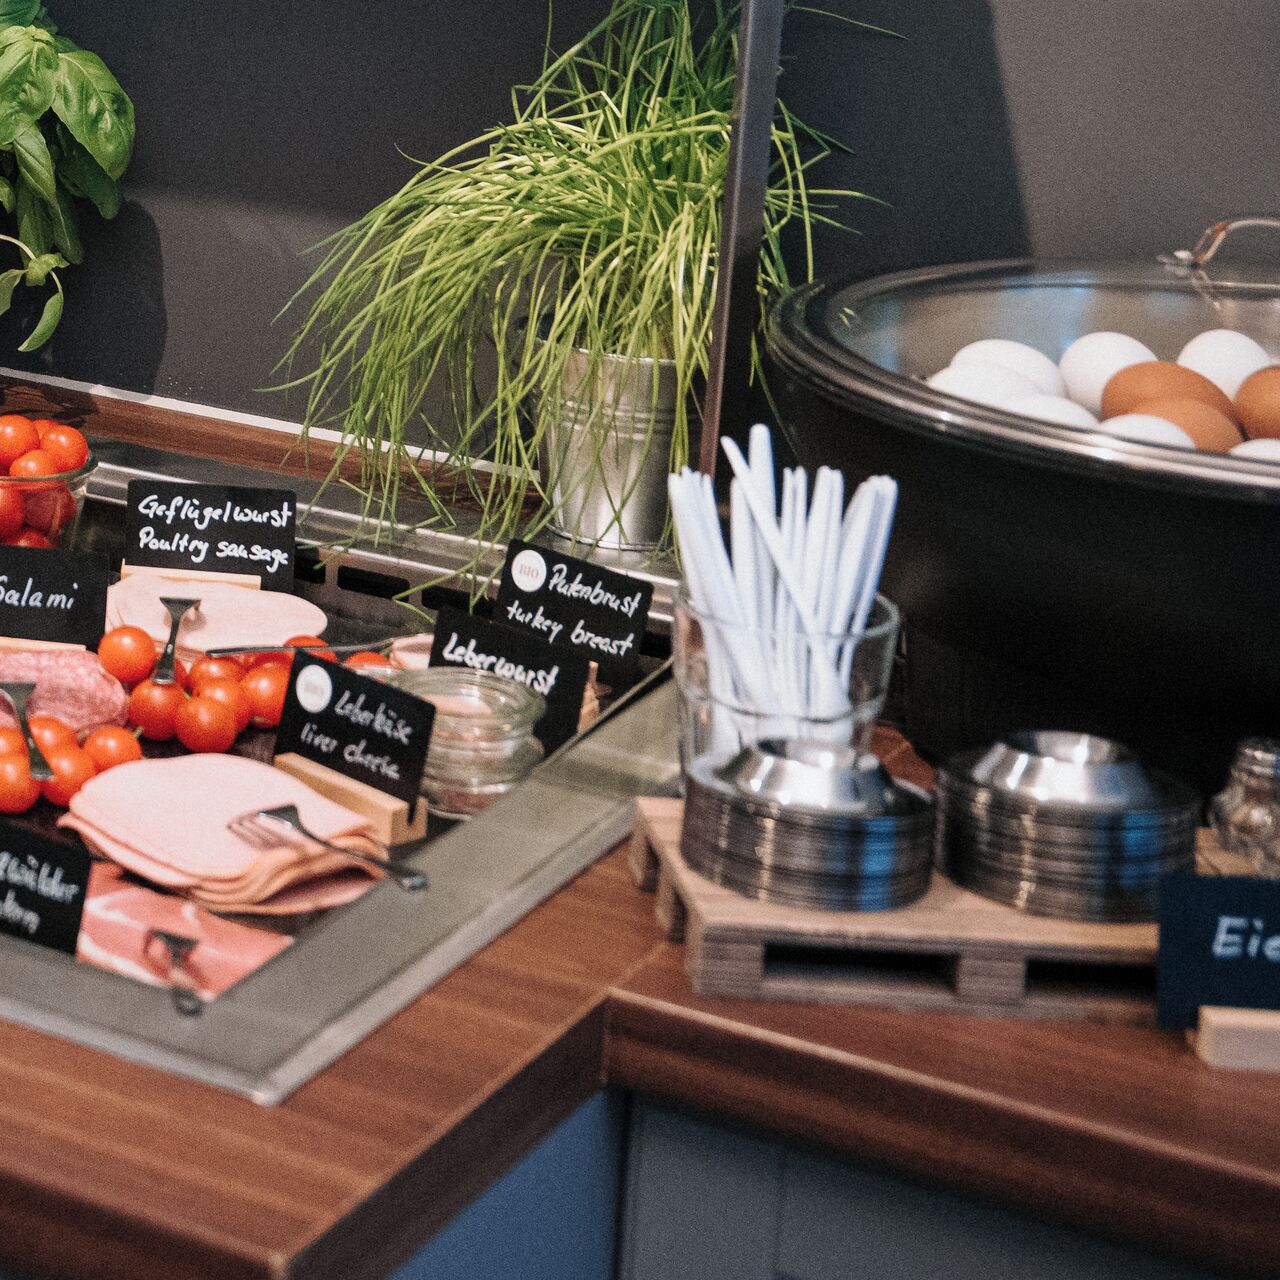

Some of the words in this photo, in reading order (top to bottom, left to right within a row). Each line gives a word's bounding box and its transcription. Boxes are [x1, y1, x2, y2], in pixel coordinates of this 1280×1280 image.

[138, 494, 293, 531] Geflügelwurst
[139, 526, 209, 563] Poultry
[216, 541, 289, 574] sausage
[519, 563, 540, 579] BIO
[548, 563, 642, 618] Putenbrust
[506, 599, 564, 644] turkey
[570, 619, 635, 657] breast
[442, 632, 560, 696] Leberwurst
[301, 722, 338, 753] liver
